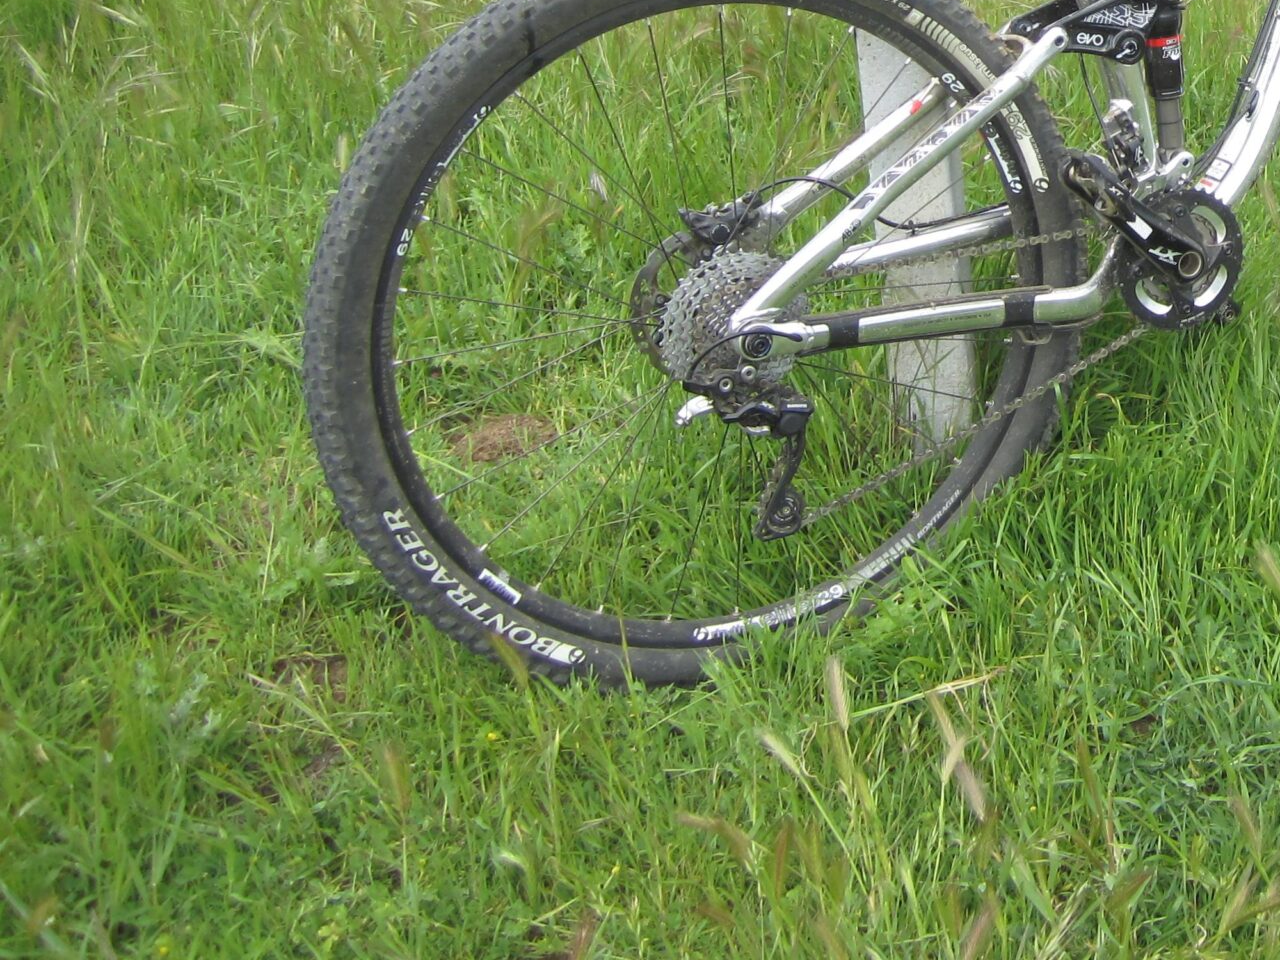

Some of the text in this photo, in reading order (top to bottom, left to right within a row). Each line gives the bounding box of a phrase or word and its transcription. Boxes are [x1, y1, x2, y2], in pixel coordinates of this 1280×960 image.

[1076, 32, 1103, 46] evo
[941, 72, 965, 92] 29
[397, 228, 414, 257] 29
[916, 489, 961, 539] BONTRAGER
[383, 509, 556, 657] BONTRAGER
[816, 585, 843, 606] 29
